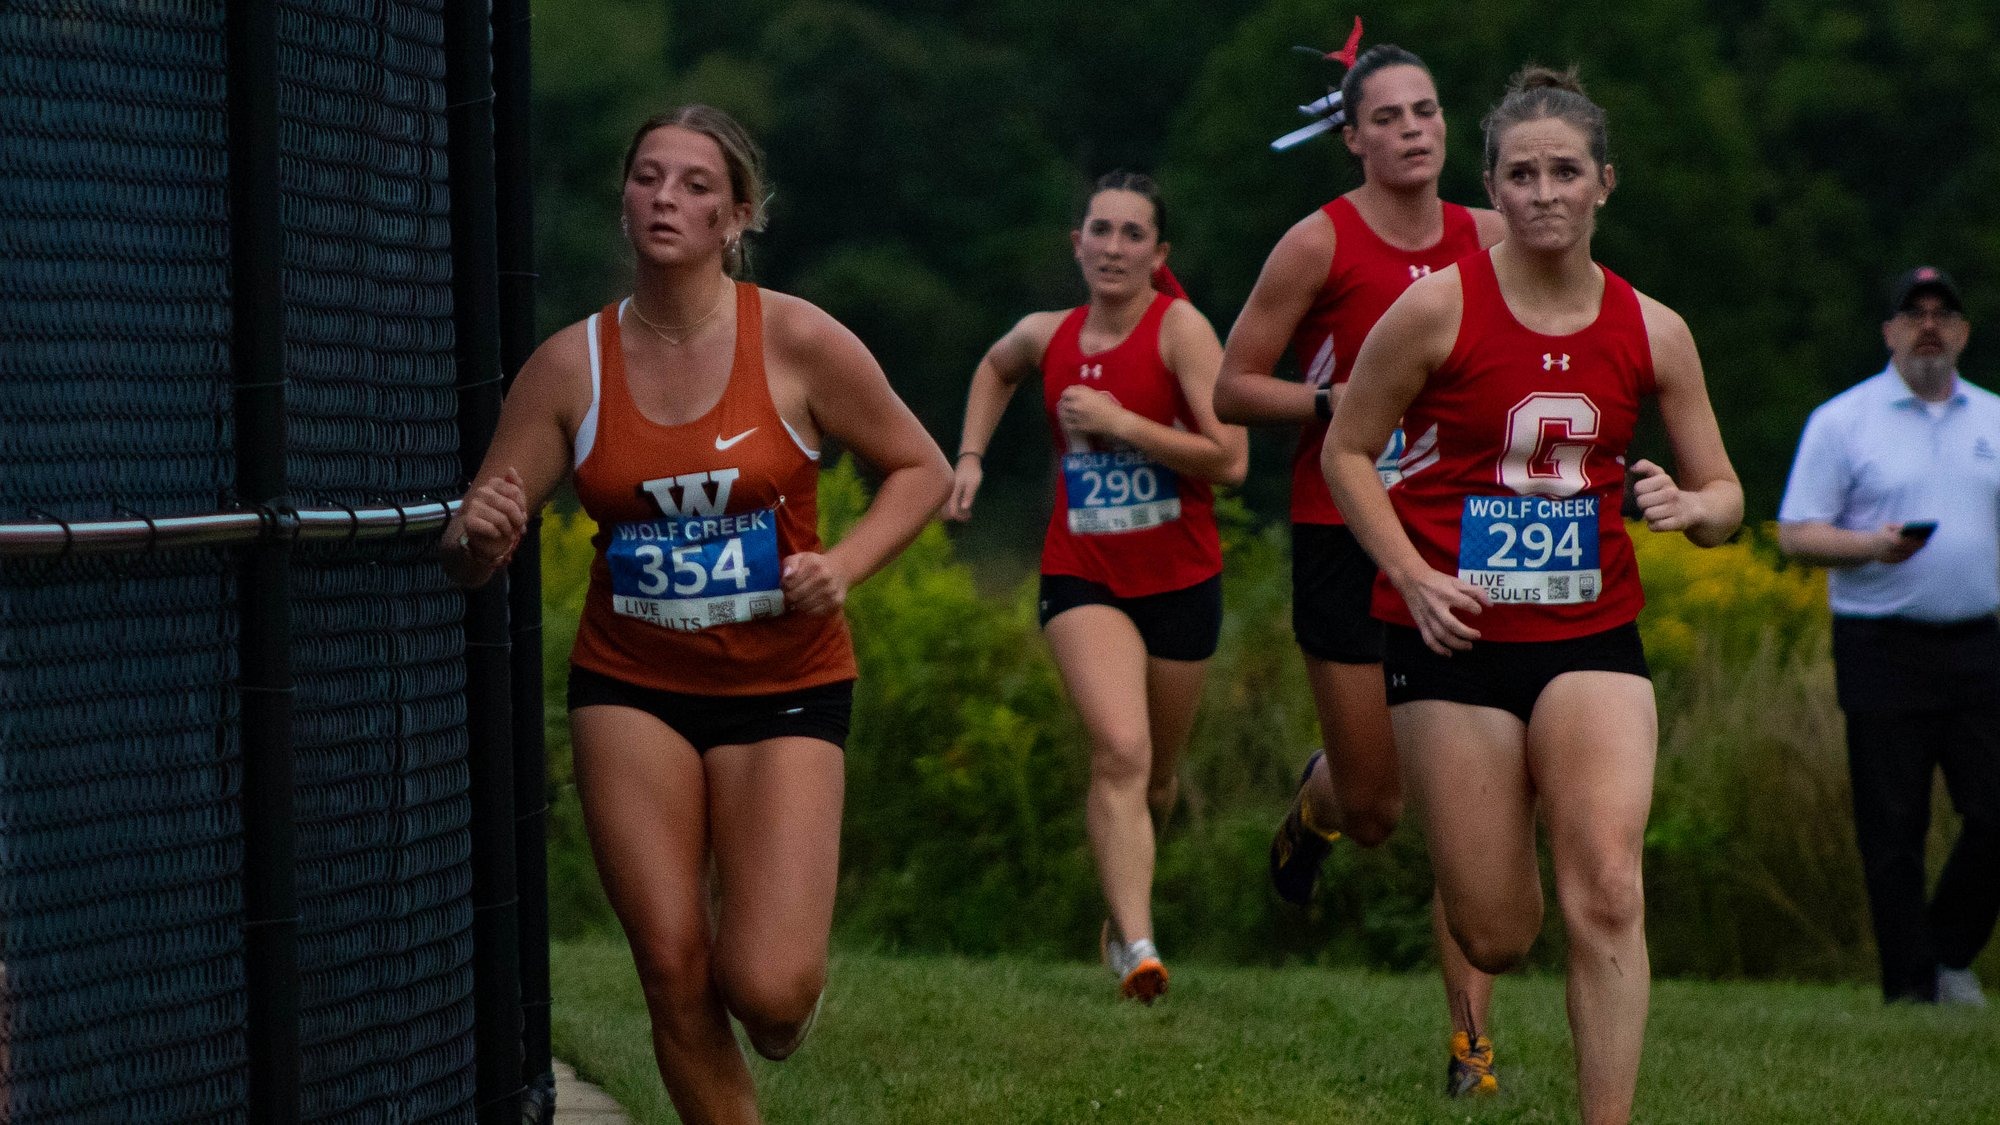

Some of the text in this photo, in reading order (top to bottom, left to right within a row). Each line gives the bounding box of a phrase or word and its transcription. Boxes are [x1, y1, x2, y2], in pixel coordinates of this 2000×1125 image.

[1496, 391, 1601, 498] G
[643, 467, 740, 517] W
[1081, 467, 1157, 506] 290
[619, 510, 768, 541] WOLF CREEK
[1469, 498, 1596, 519] WOLF CREEK
[1487, 521, 1583, 568] 294
[635, 538, 750, 595] 354
[1470, 573, 1505, 587] LIVE
[625, 599, 660, 616] LIVE
[1484, 587, 1541, 601] SULTS
